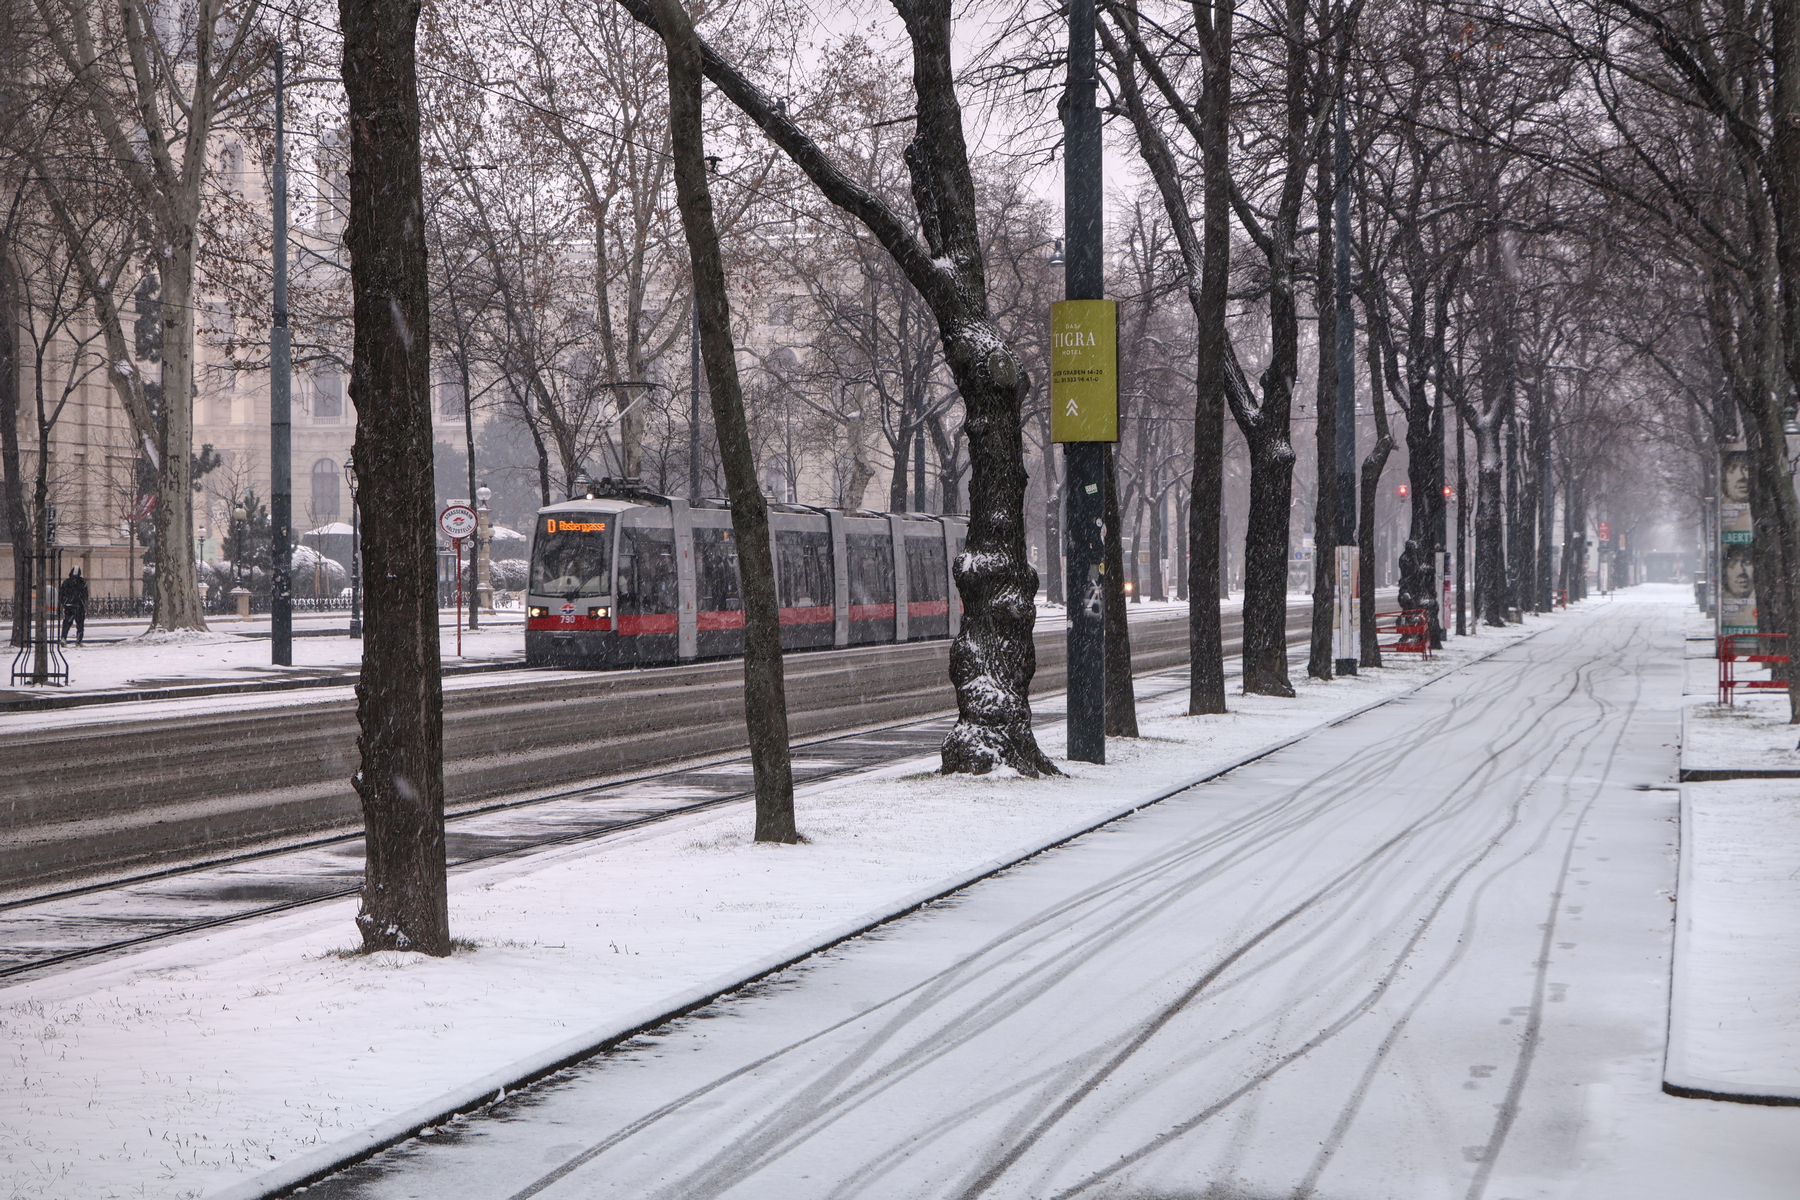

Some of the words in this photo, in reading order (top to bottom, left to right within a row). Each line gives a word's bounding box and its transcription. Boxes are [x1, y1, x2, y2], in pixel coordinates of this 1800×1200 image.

[1054, 331, 1096, 348] TIGRA
[444, 510, 474, 520] STRASSENBAHN
[445, 524, 472, 534] HALTESTELLE
[547, 519, 557, 533] D
[560, 615, 576, 624] 790
